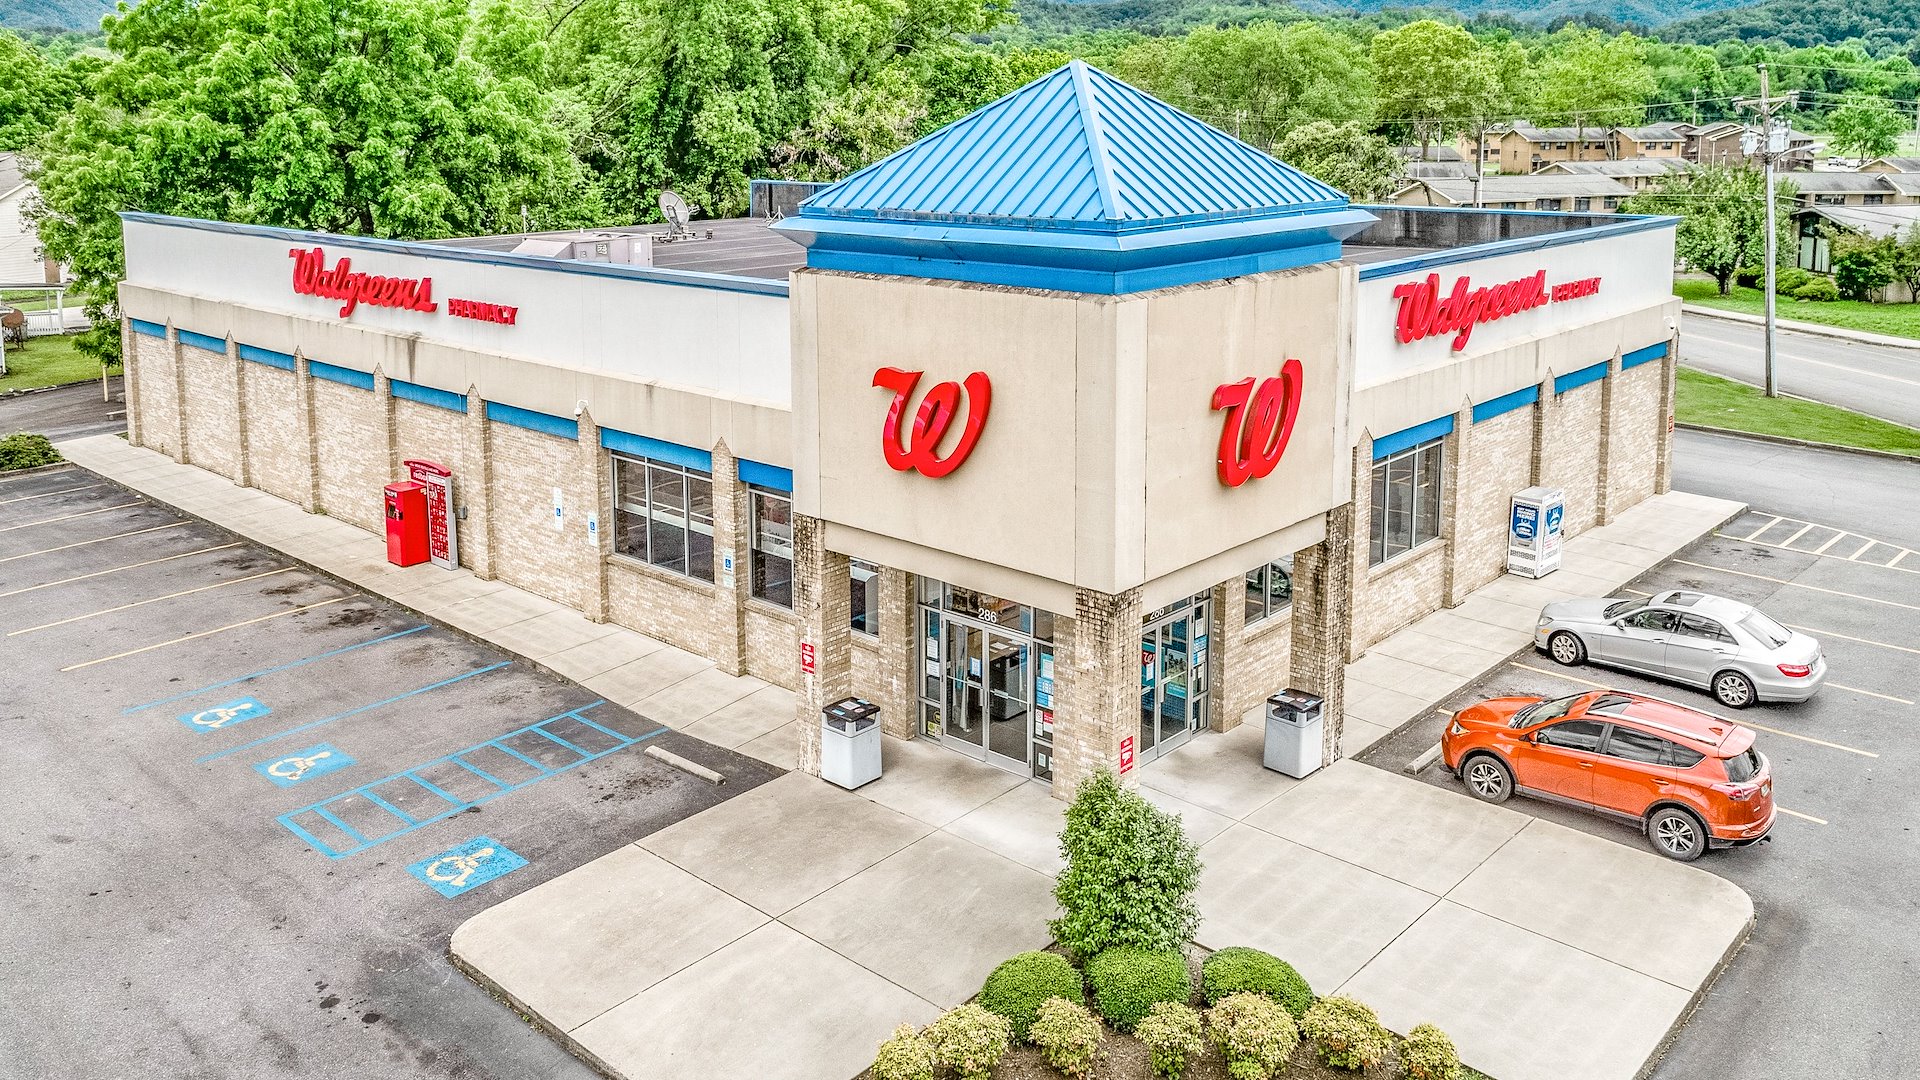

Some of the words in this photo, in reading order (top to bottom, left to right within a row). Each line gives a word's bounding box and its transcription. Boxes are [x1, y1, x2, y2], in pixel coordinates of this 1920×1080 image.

[289, 248, 438, 318] Walgreens
[448, 298, 518, 325] PHARMACY
[1393, 270, 1550, 352] Walgreens
[1551, 277, 1602, 302] PHARMACY
[872, 366, 992, 478] W
[1211, 359, 1303, 488] W
[978, 607, 997, 623] 286
